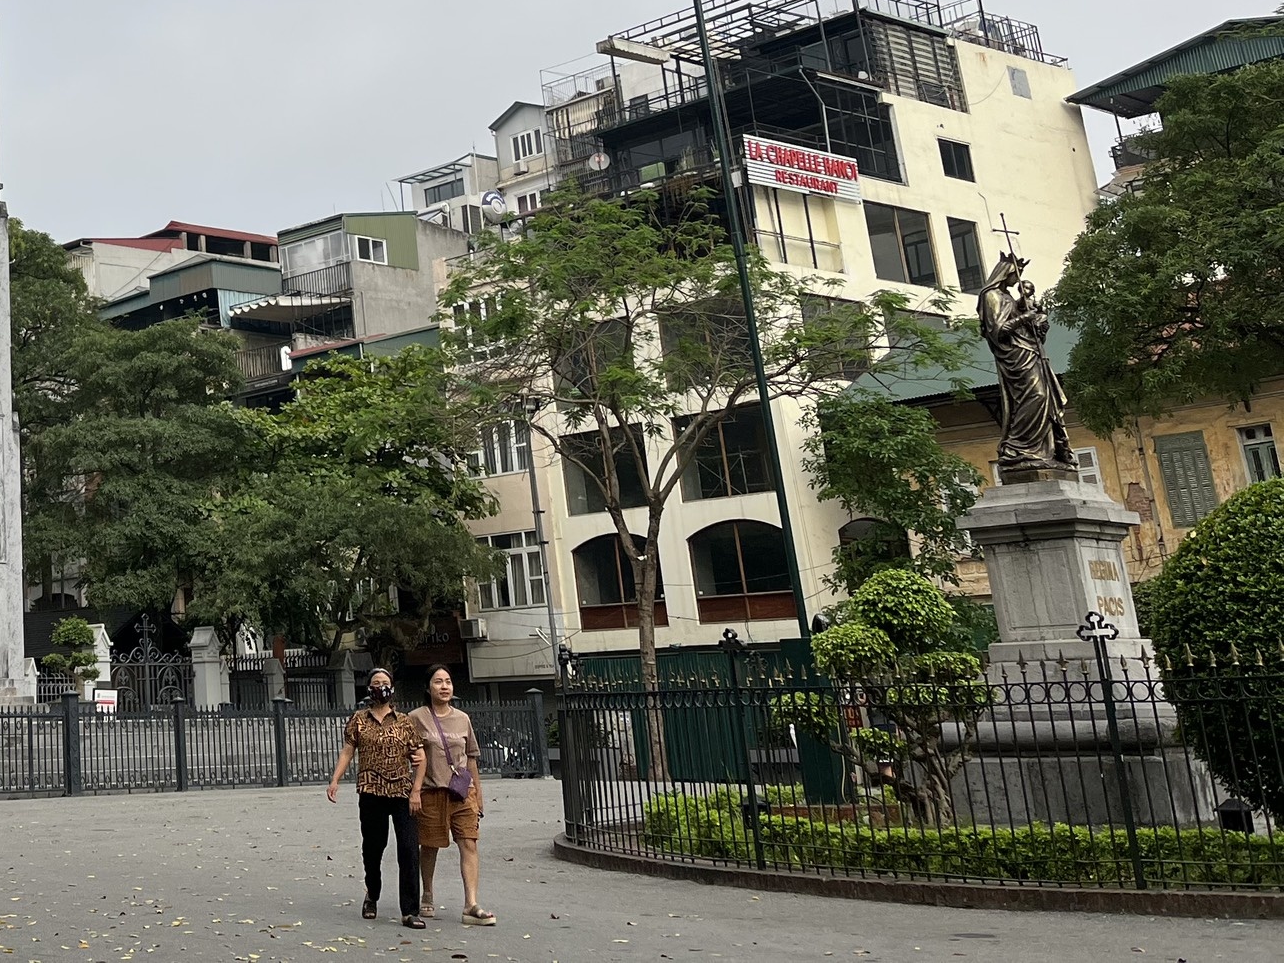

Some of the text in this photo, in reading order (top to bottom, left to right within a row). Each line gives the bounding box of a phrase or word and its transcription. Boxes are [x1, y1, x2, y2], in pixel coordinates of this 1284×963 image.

[748, 140, 858, 182] LA CHAPELLE HANOI
[775, 169, 838, 194] RESTAURANT
[1088, 560, 1120, 582] REGINA
[1097, 596, 1125, 617] PACIS
